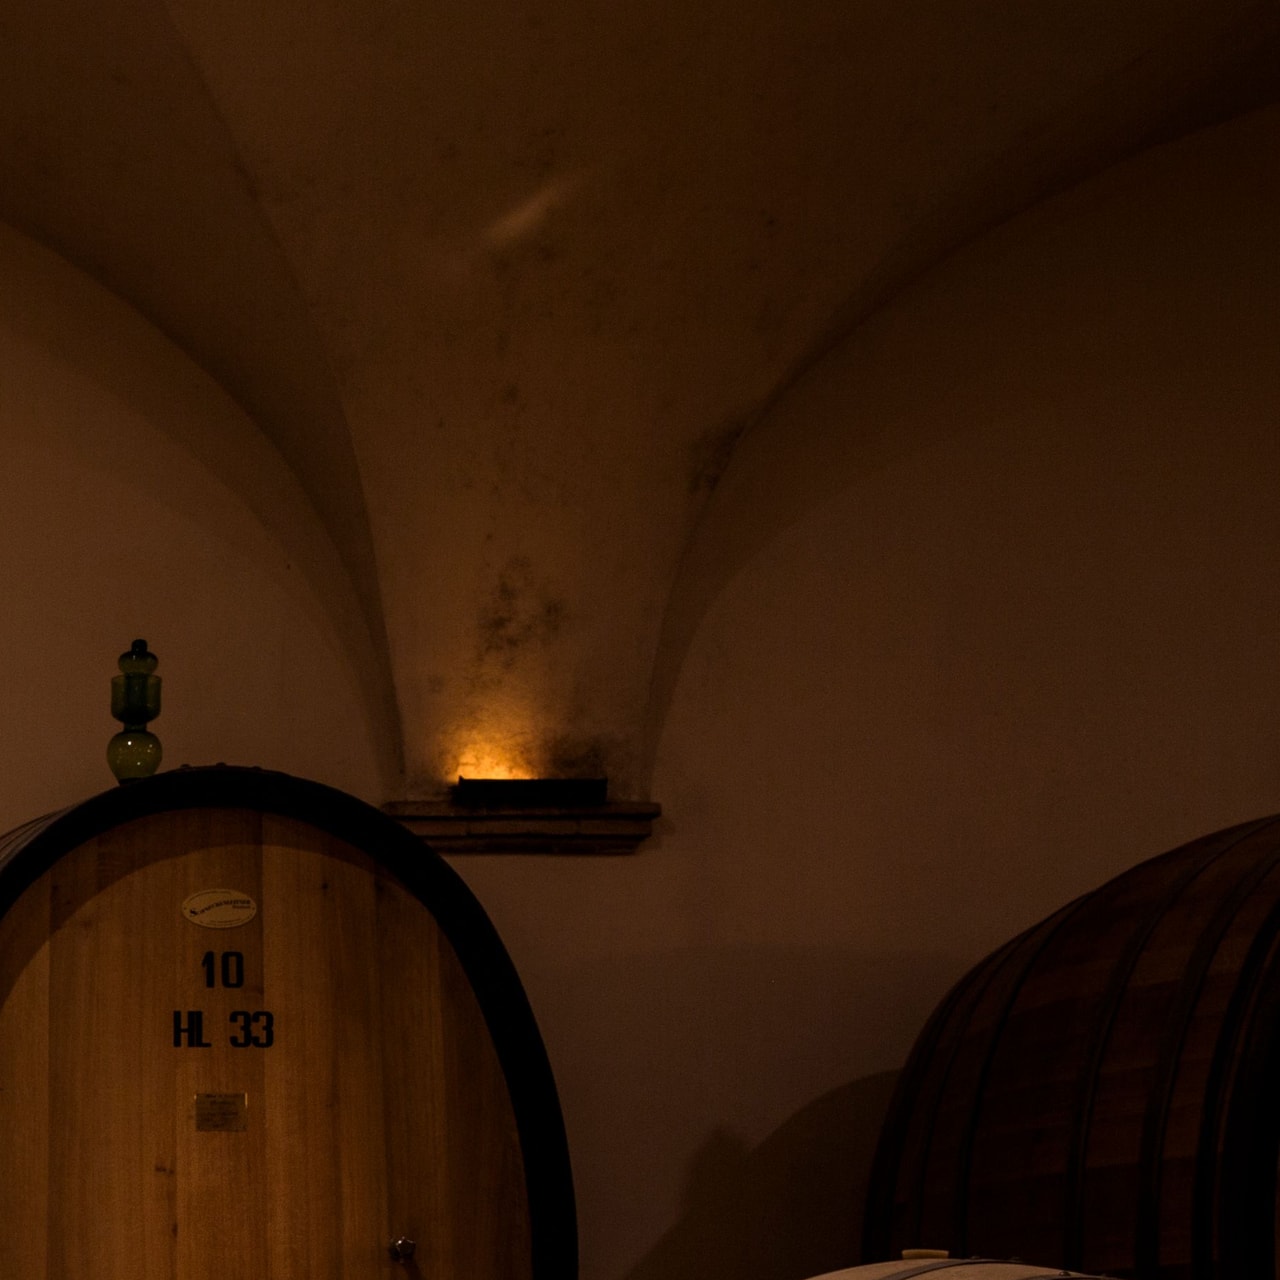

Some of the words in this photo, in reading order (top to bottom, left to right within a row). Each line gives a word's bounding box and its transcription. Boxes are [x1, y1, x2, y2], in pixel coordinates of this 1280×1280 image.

[201, 950, 245, 989] 10
[172, 1010, 212, 1049] HL
[229, 1010, 274, 1049] 33
